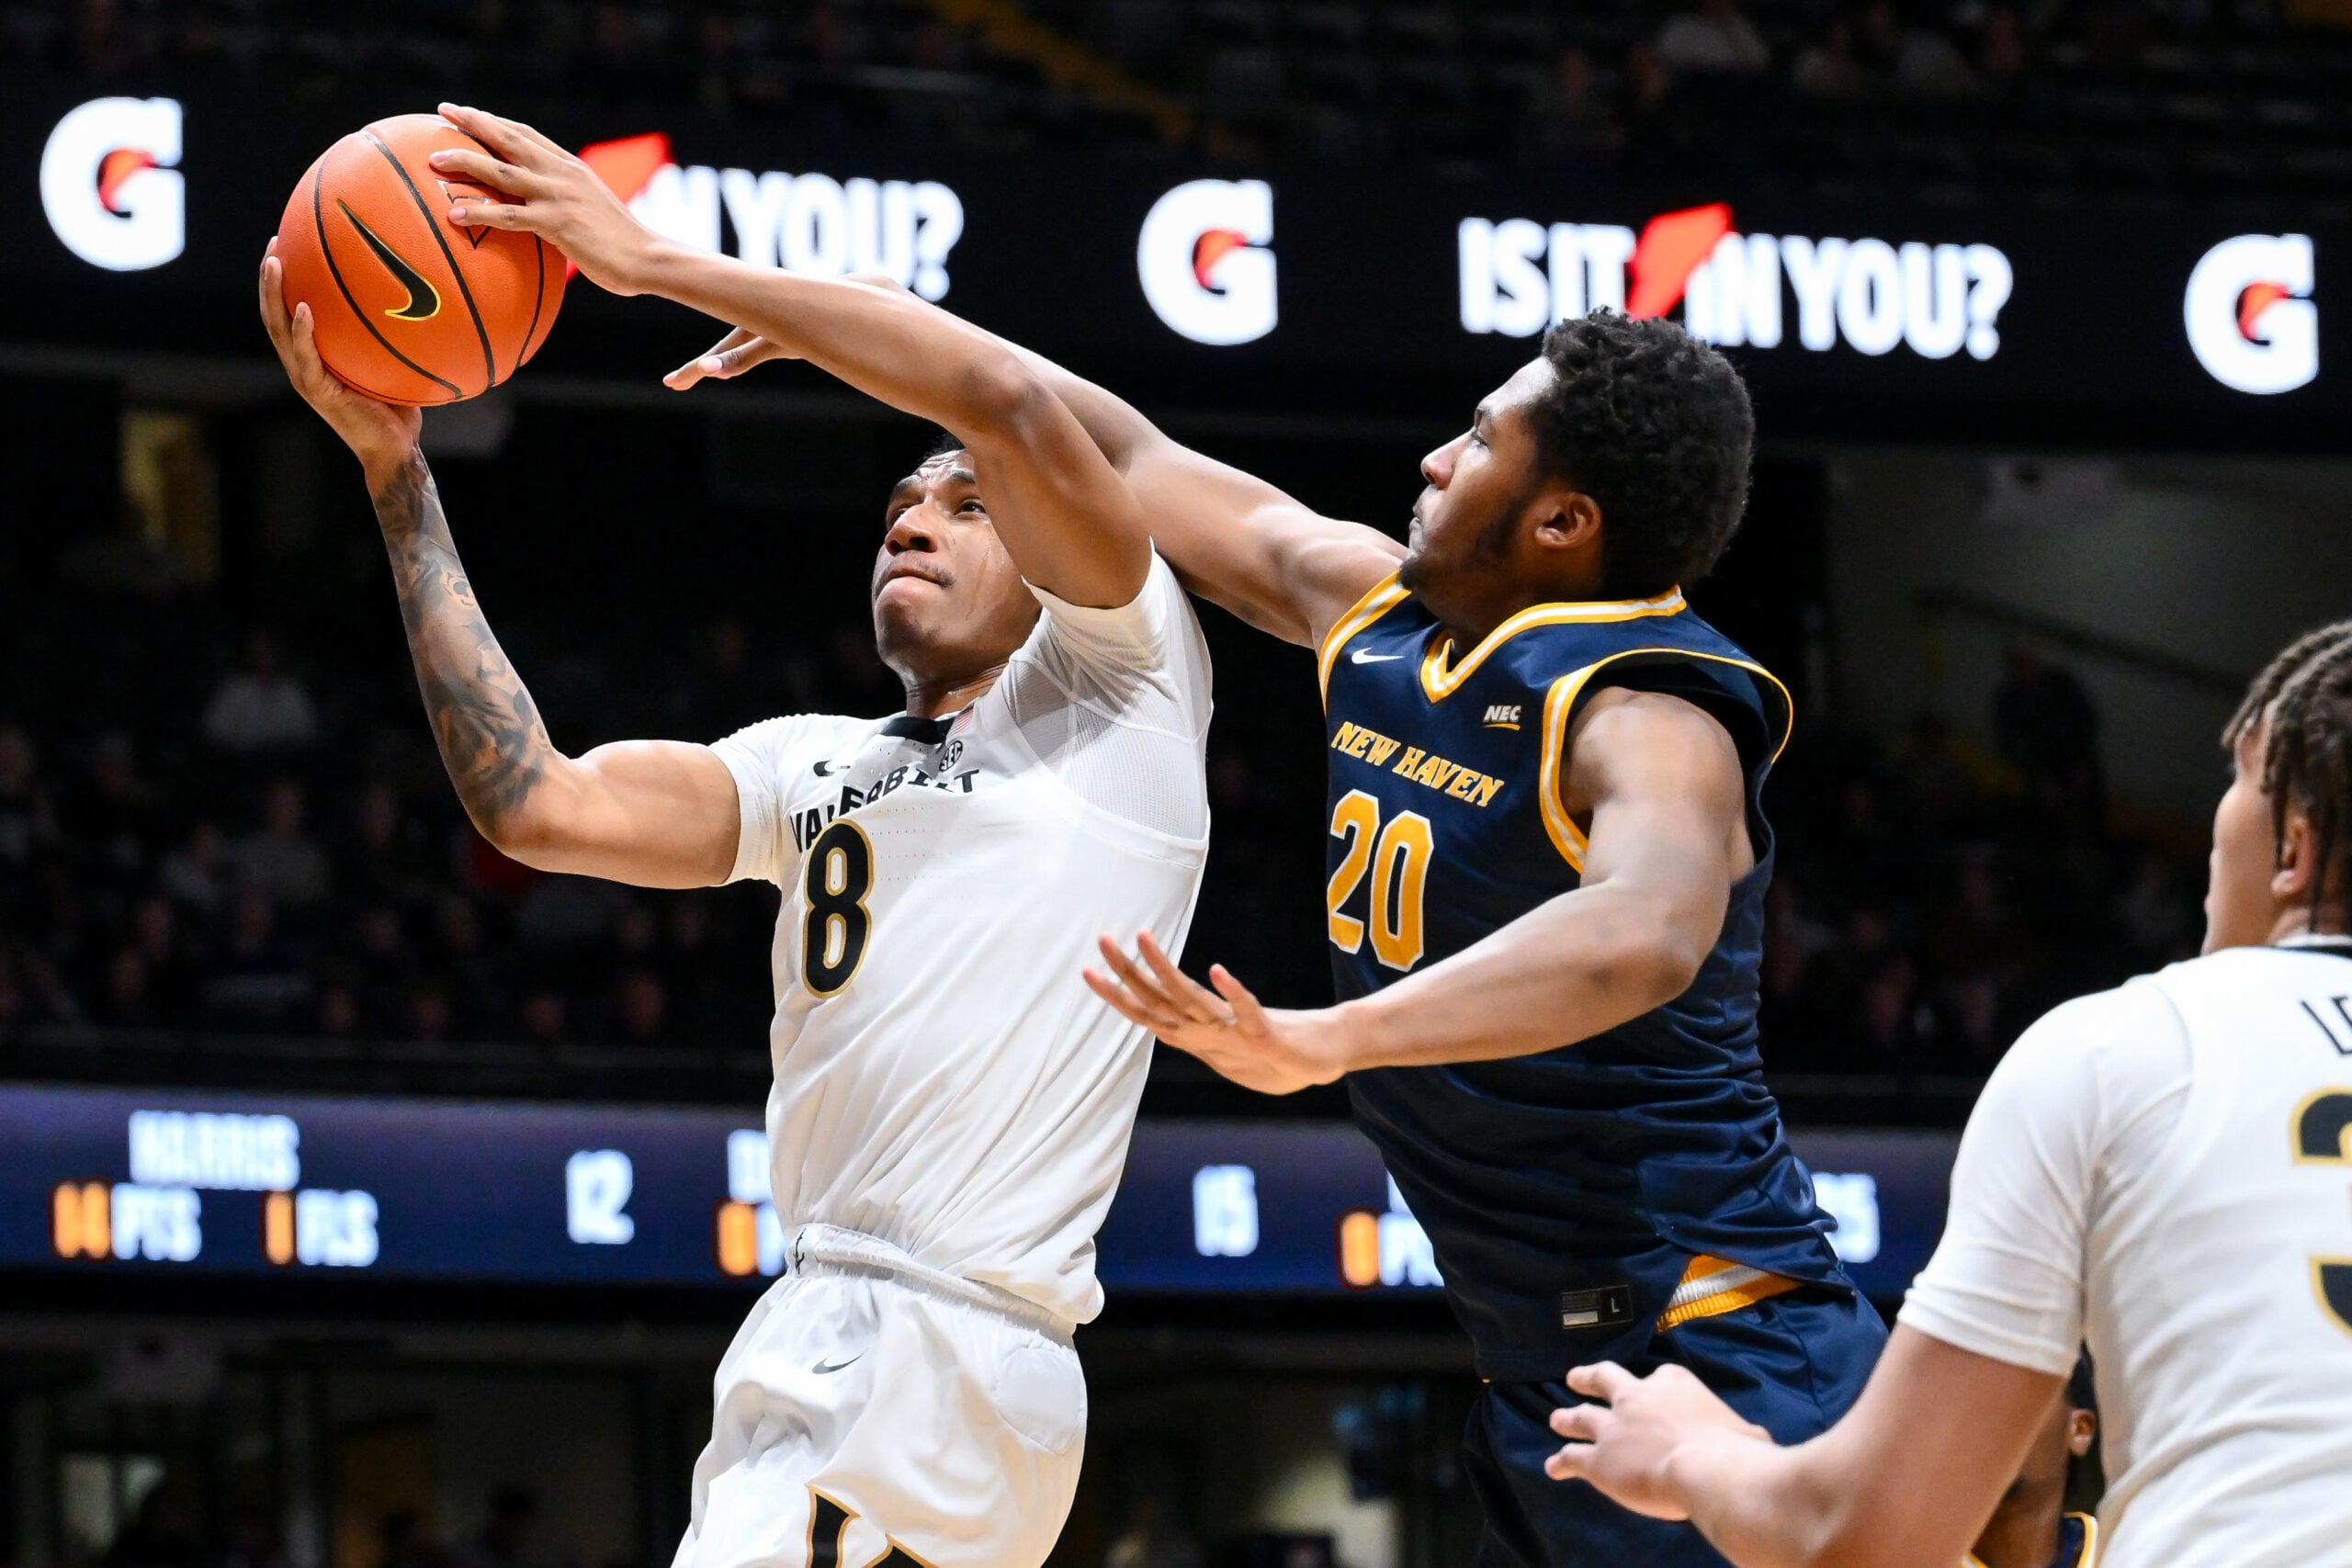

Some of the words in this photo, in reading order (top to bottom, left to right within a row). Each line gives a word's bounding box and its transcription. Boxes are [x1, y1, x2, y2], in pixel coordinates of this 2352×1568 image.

[40, 96, 185, 271] G
[720, 170, 963, 302] YOU?
[1138, 179, 1278, 345] G
[1460, 218, 1550, 337] IS
[1781, 235, 2013, 361] YOU?
[2185, 234, 2319, 394] G
[941, 742, 962, 771] SEC
[1331, 721, 1401, 766] NEW
[1392, 745, 1505, 807] HAVEN
[1483, 705, 1521, 722] NEC
[801, 818, 874, 998] 8
[1327, 789, 1434, 973] 20
[1610, 1295, 1621, 1314] L
